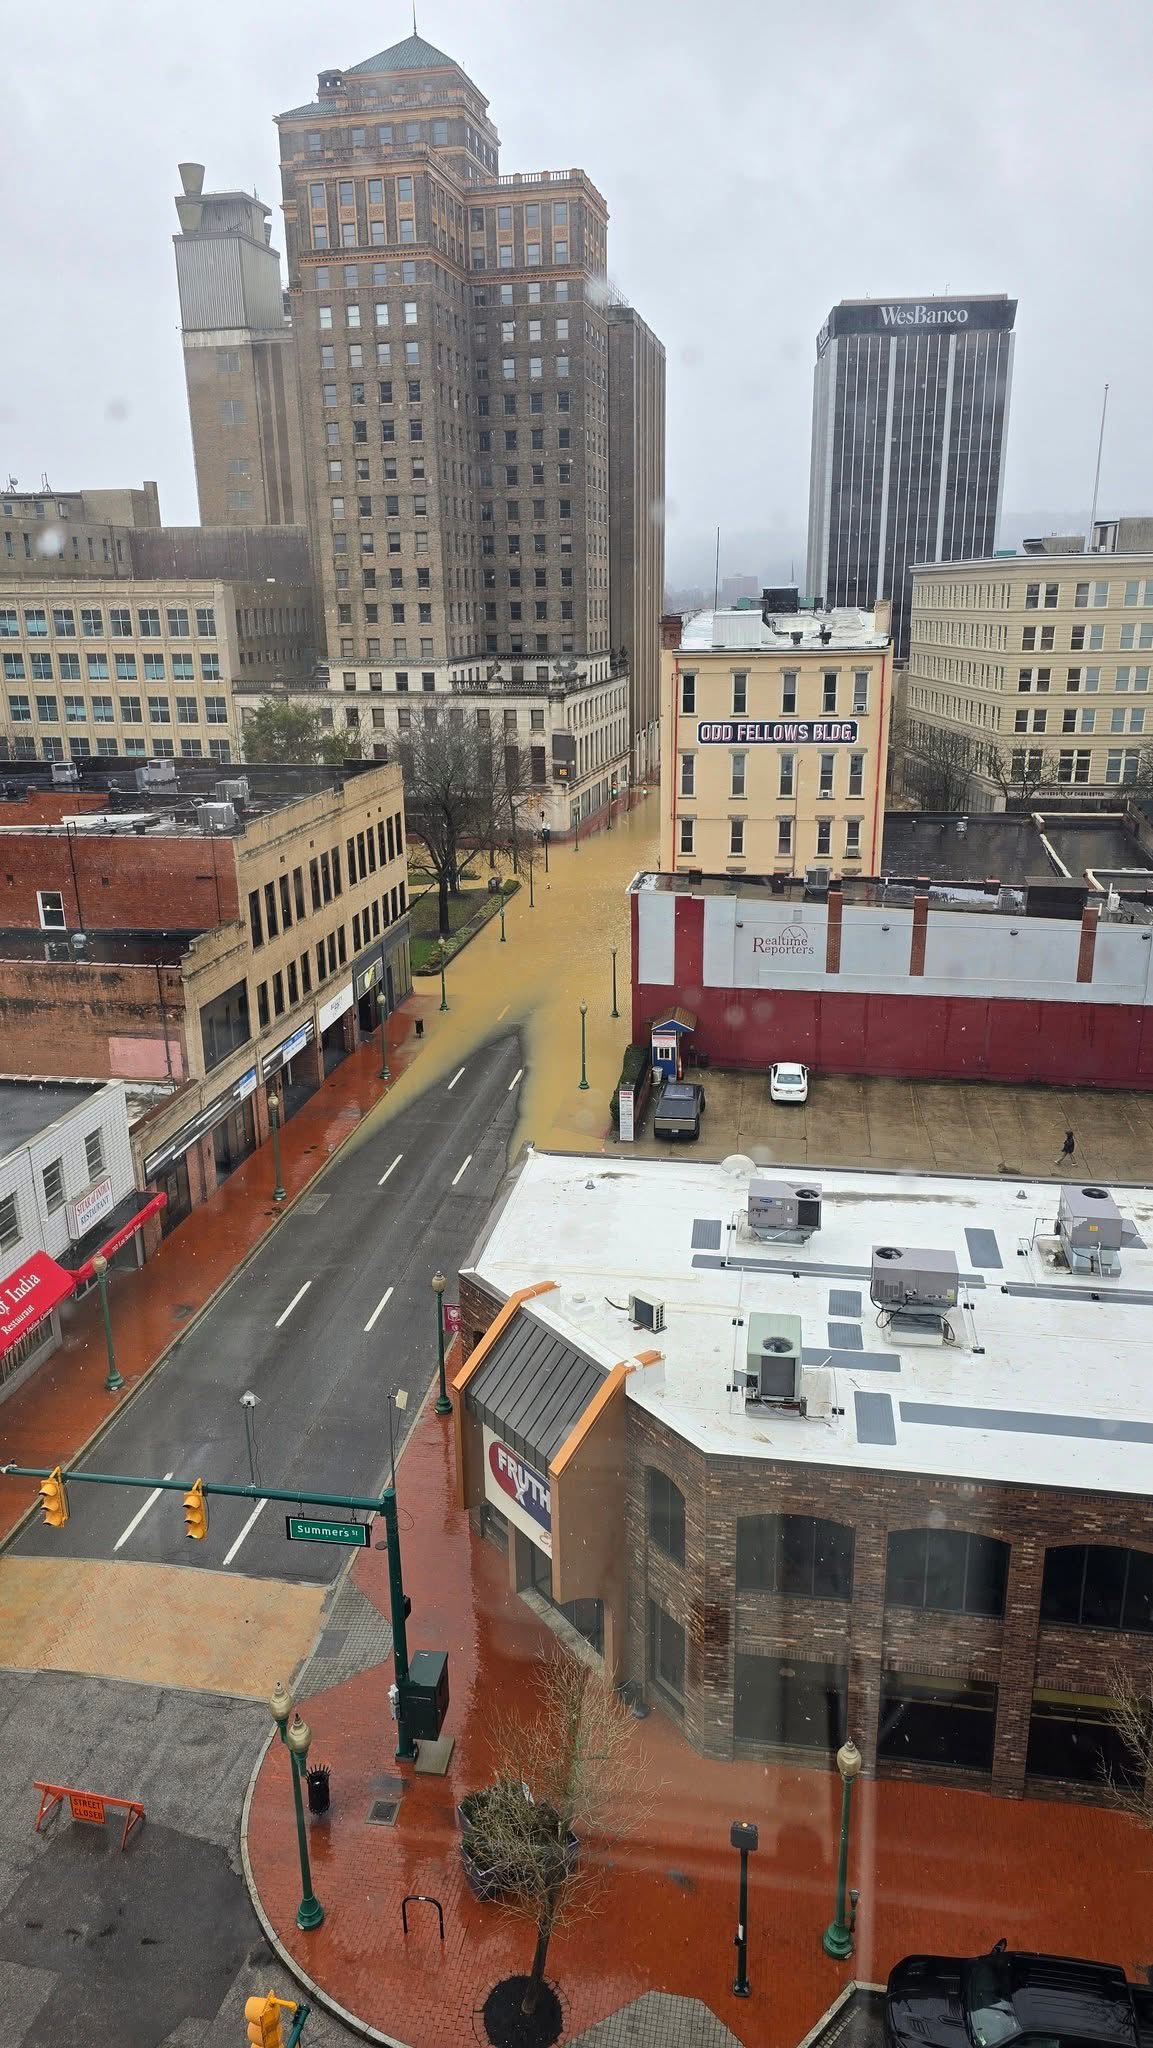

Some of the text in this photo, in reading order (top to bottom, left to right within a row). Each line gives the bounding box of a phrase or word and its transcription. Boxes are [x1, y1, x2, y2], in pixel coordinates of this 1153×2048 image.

[880, 305, 968, 325] WesBanco
[701, 724, 856, 741] ODD FELLOWS BLDG.
[753, 936, 808, 949] Realtime
[753, 944, 815, 956] Reporters
[81, 1195, 109, 1225] RESTAURANT
[5, 1273, 41, 1303] India
[1, 1304, 35, 1335] Restaurant
[498, 1447, 551, 1514] FRUTH
[297, 1525, 350, 1537] Summers
[73, 1799, 101, 1809] STREET
[74, 1808, 103, 1820] CLOSED
